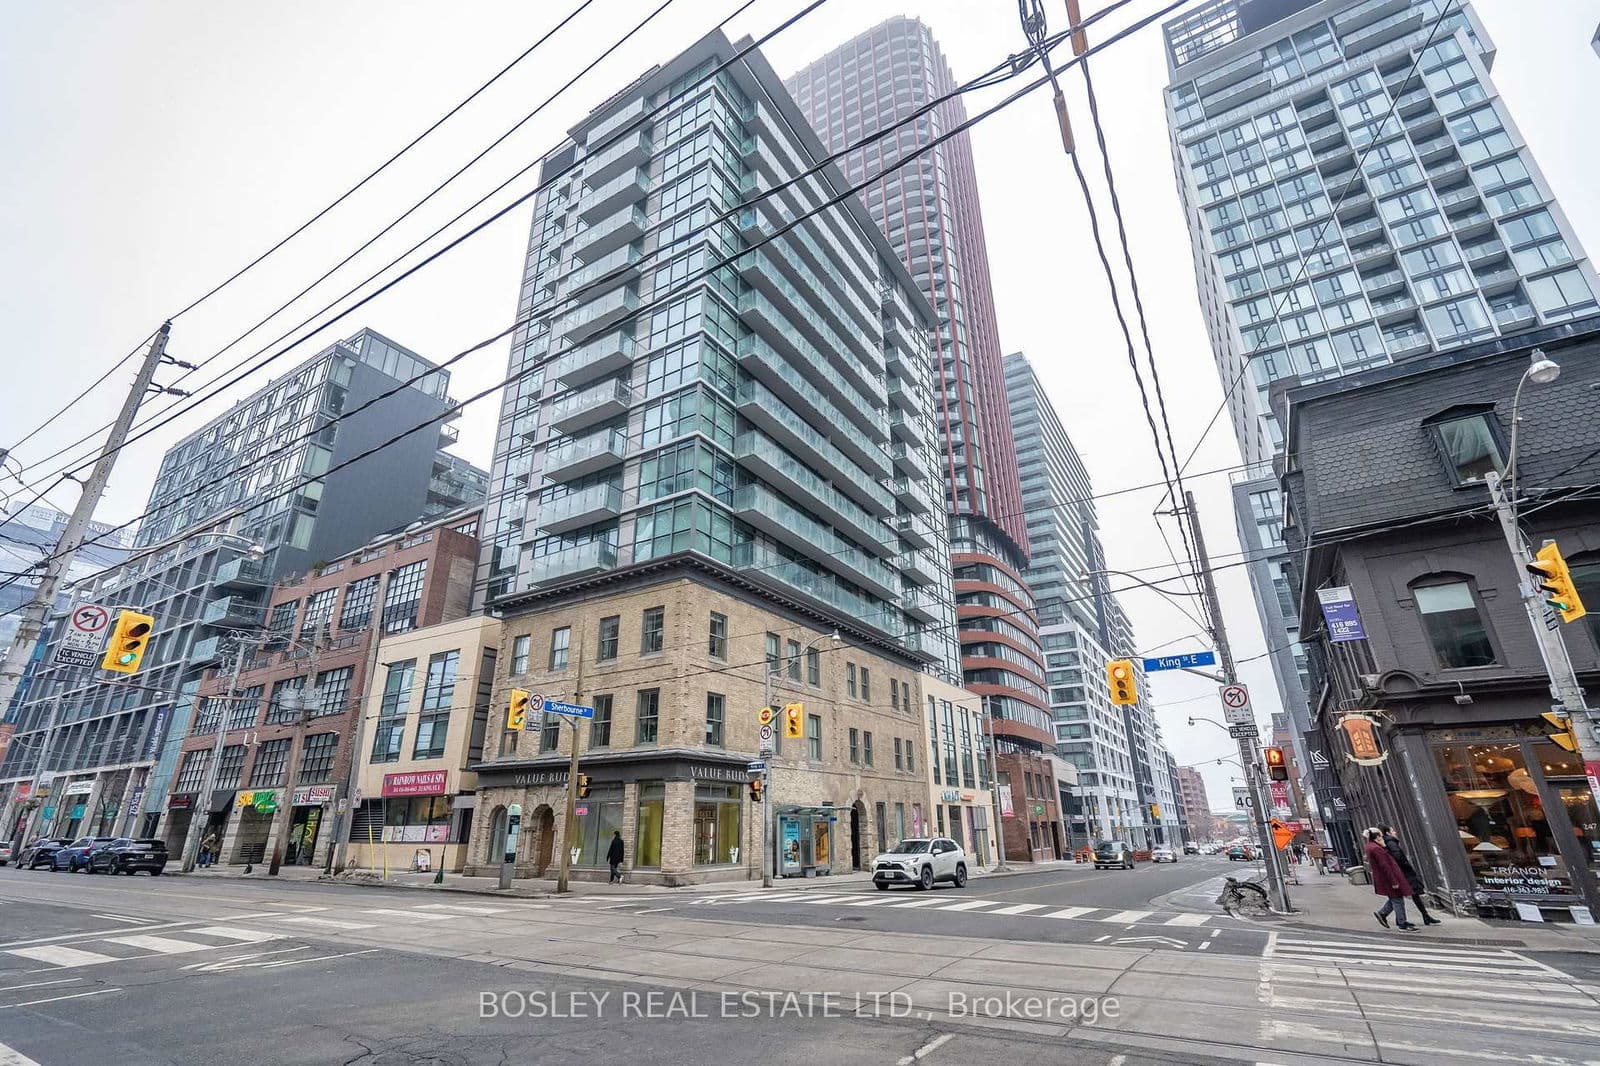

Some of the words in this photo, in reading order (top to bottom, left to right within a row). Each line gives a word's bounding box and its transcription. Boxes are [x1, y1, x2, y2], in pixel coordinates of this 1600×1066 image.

[1159, 657, 1181, 669] King
[1190, 654, 1198, 664] E
[551, 702, 584, 715] Sherbourne
[515, 773, 545, 784] VALUE
[549, 772, 571, 782] BUD
[690, 766, 722, 779] VALUE
[725, 770, 750, 780] BUDS
[1236, 796, 1253, 807] 40
[1491, 866, 1548, 876] TRIANON
[1527, 877, 1562, 888] design
